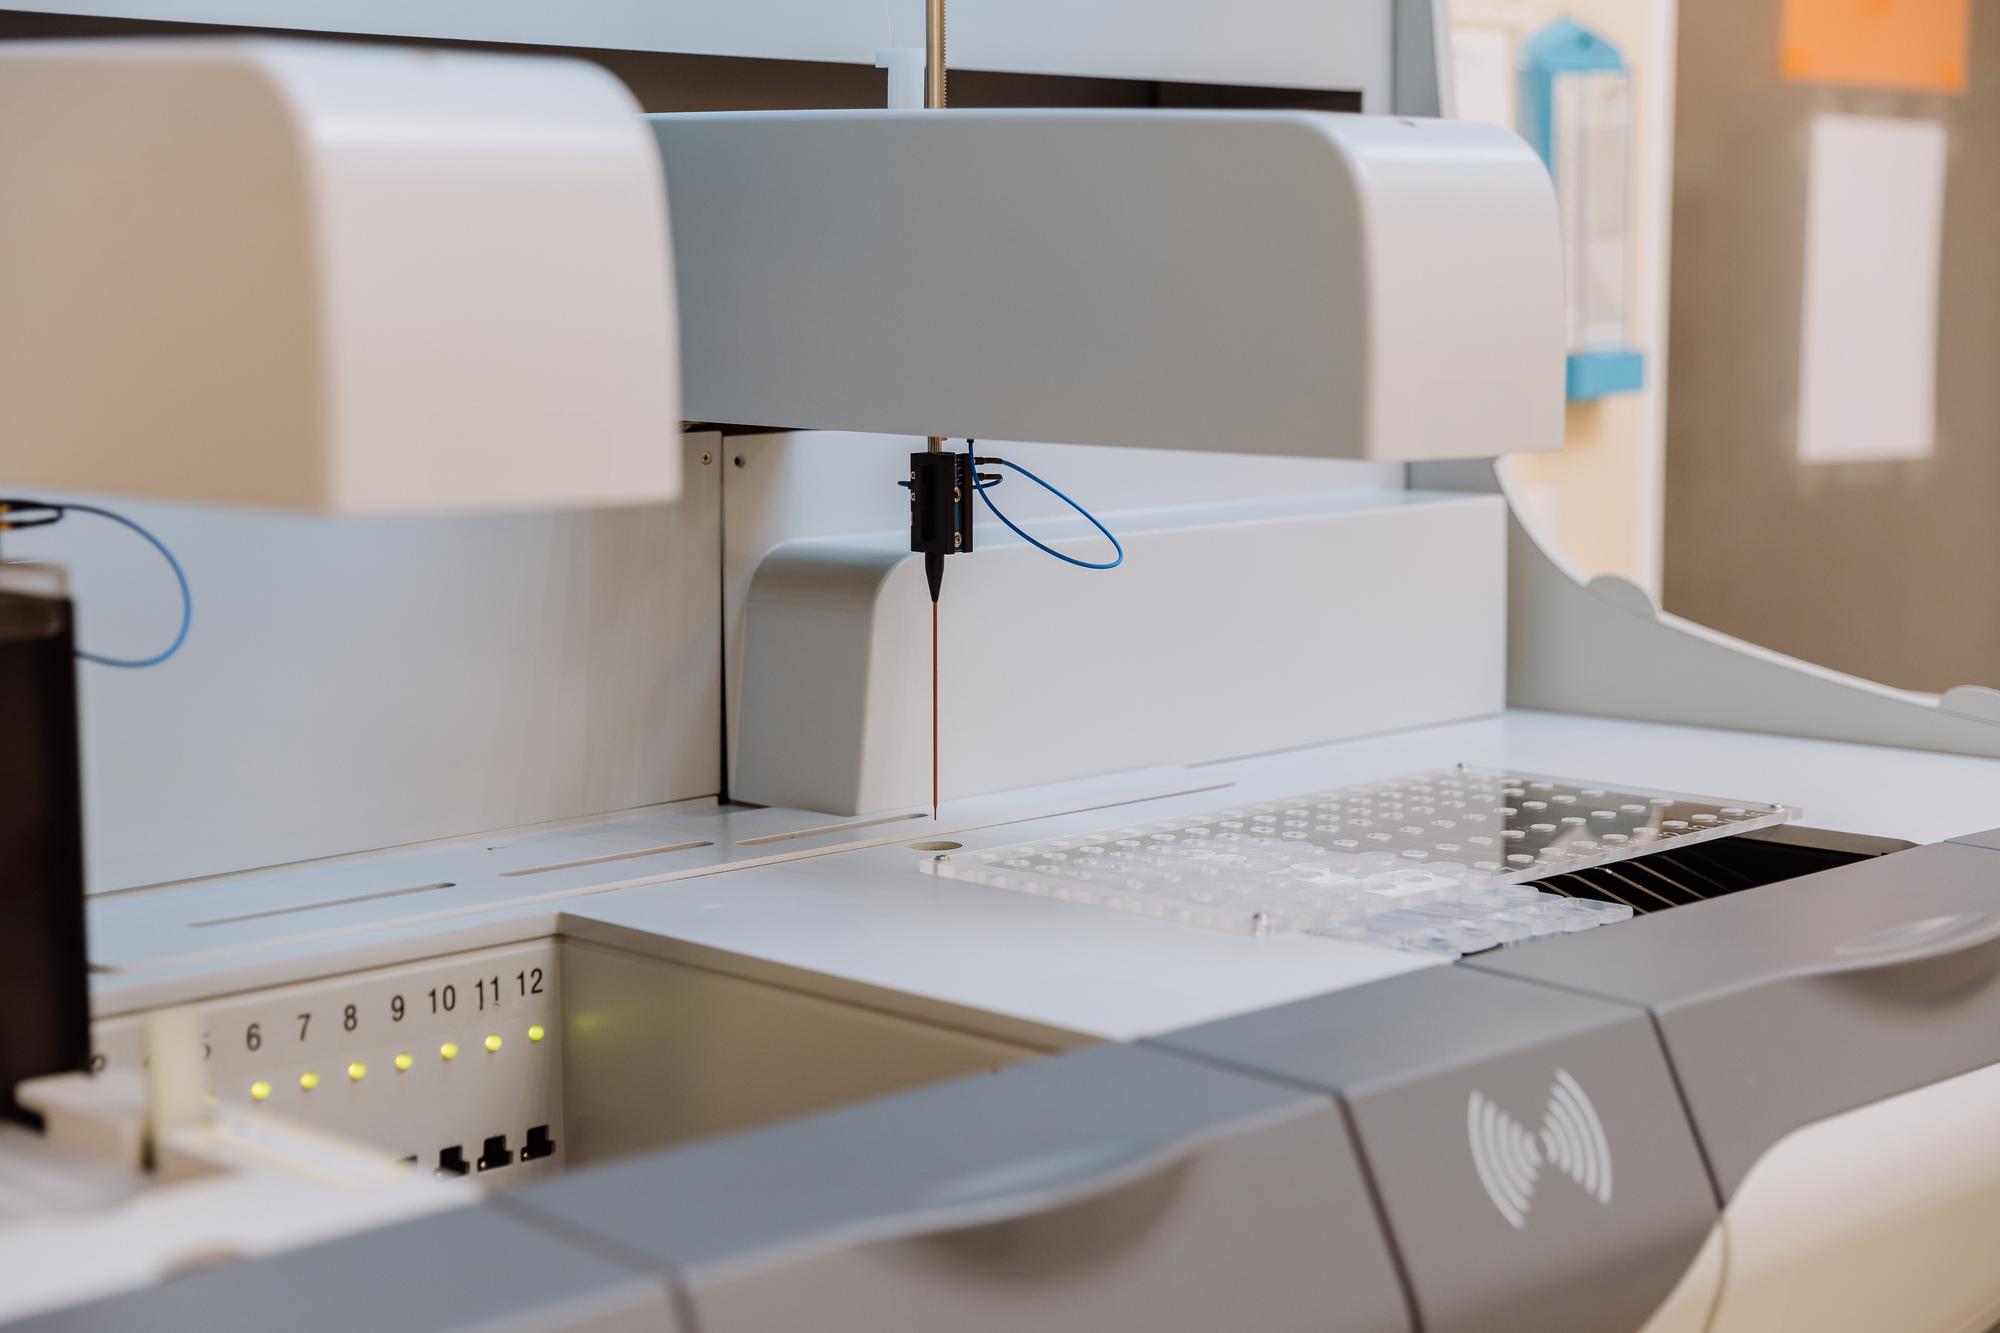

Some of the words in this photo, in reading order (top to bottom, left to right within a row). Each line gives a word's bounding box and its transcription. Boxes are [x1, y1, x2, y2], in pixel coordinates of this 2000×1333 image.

[246, 1023, 262, 1052] 6
[297, 1013, 311, 1041] 7
[343, 1004, 358, 1032] 8
[391, 995, 405, 1022] 9
[428, 984, 456, 1014] 10
[475, 976, 499, 1011] 11
[516, 967, 543, 997] 12
